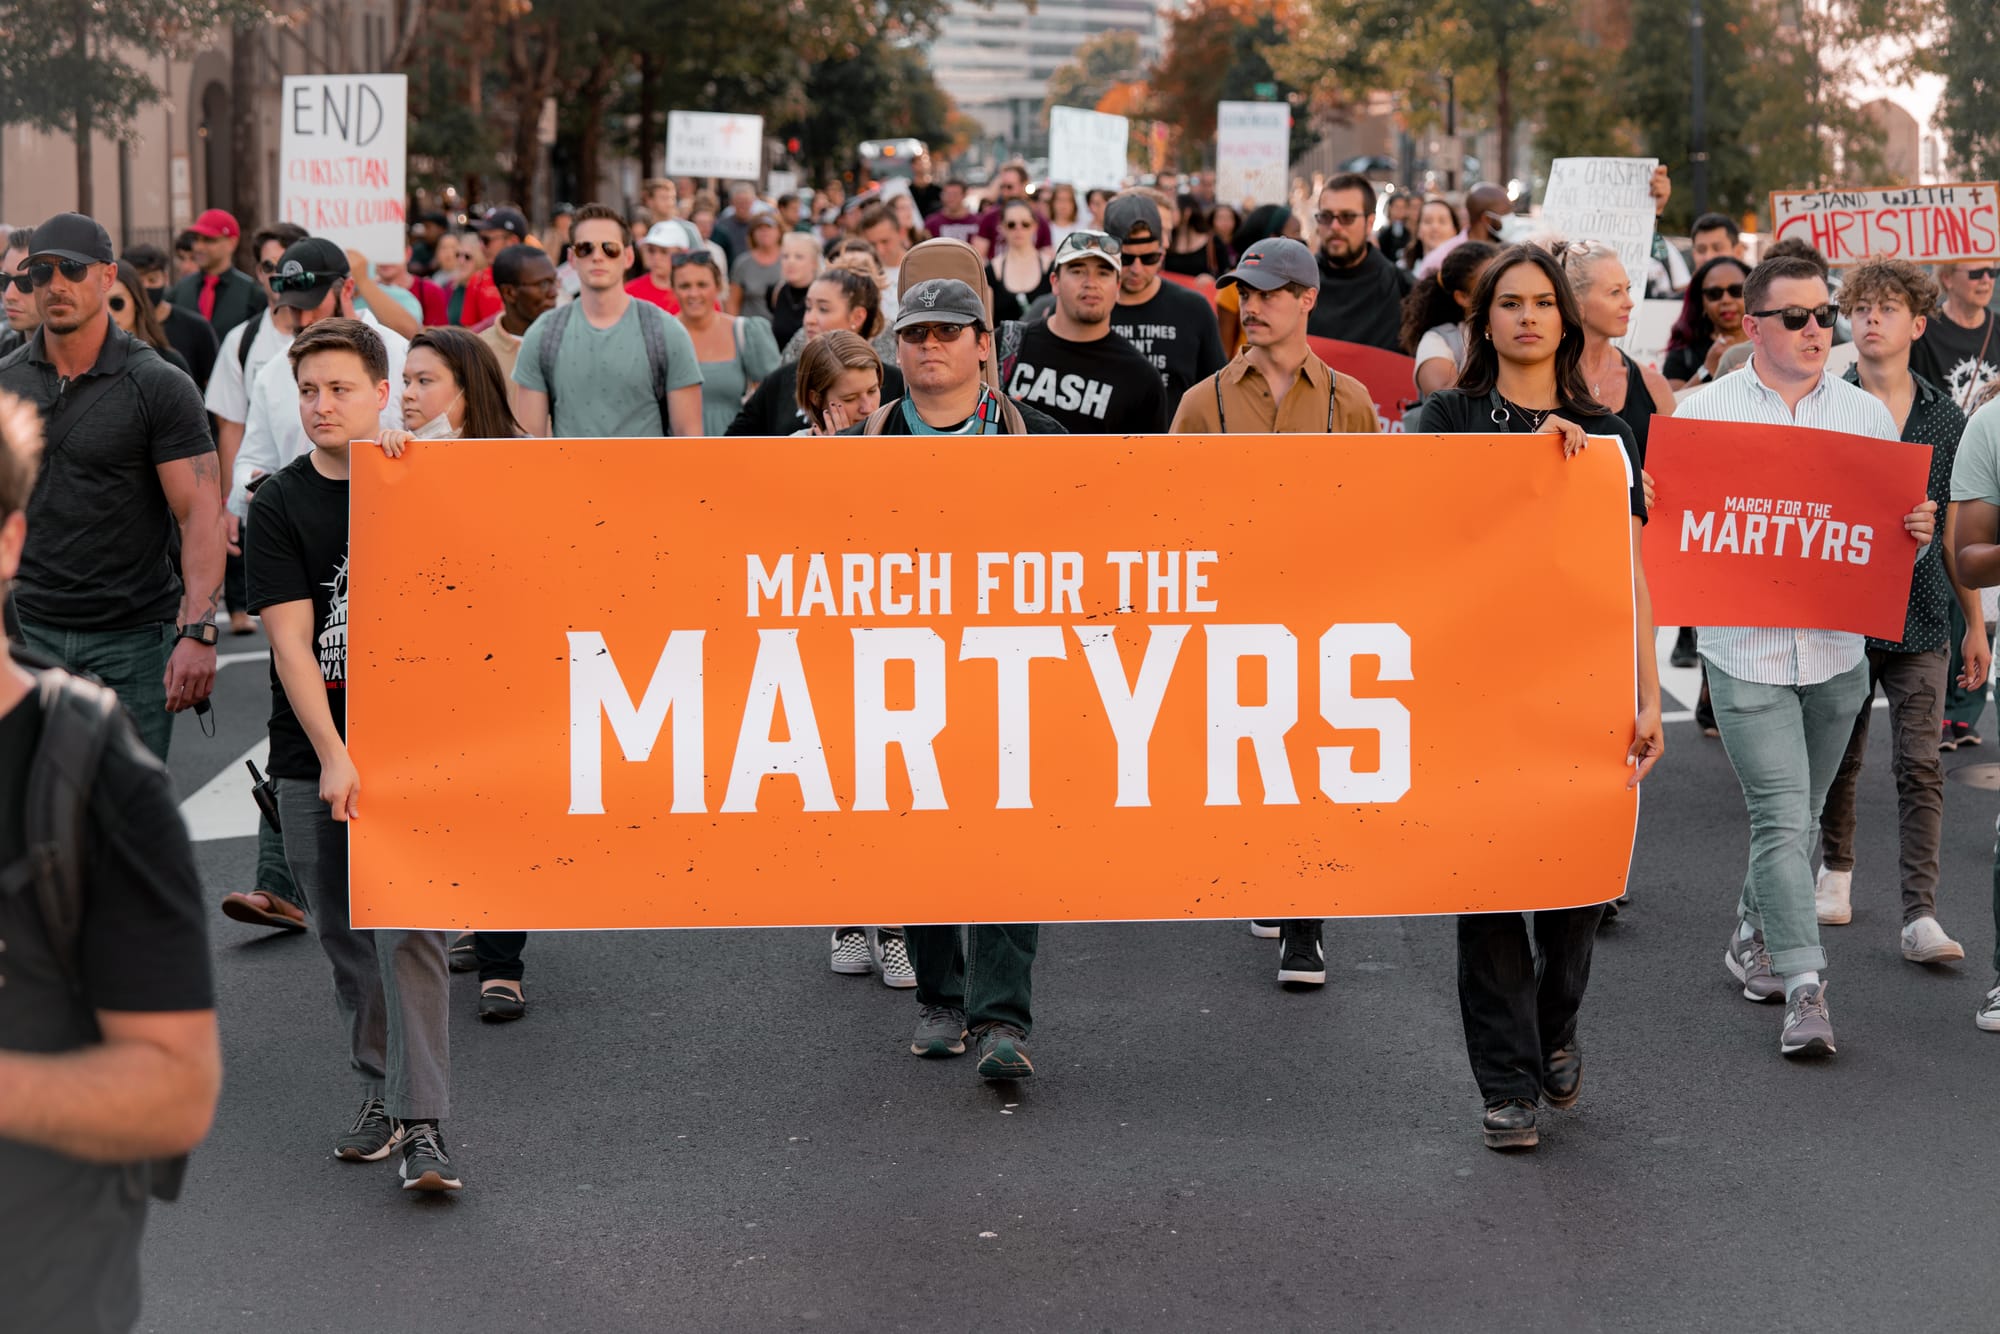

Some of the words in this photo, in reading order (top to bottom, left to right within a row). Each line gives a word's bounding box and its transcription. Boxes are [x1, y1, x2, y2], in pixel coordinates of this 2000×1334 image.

[293, 82, 383, 147] END
[1801, 191, 1868, 210] STAND
[1882, 188, 1954, 206] WITH
[1138, 325, 1176, 339] TIMES
[1008, 362, 1113, 419] CASH
[1724, 496, 1772, 515] MARCH
[1776, 500, 1802, 516] FOR
[1806, 502, 1833, 519] THE
[1679, 510, 1874, 565] MARTYRS
[745, 552, 953, 617] MARCH
[976, 551, 1084, 614] FOR
[1106, 550, 1219, 613] THE
[565, 622, 1415, 815] MARTYRS
